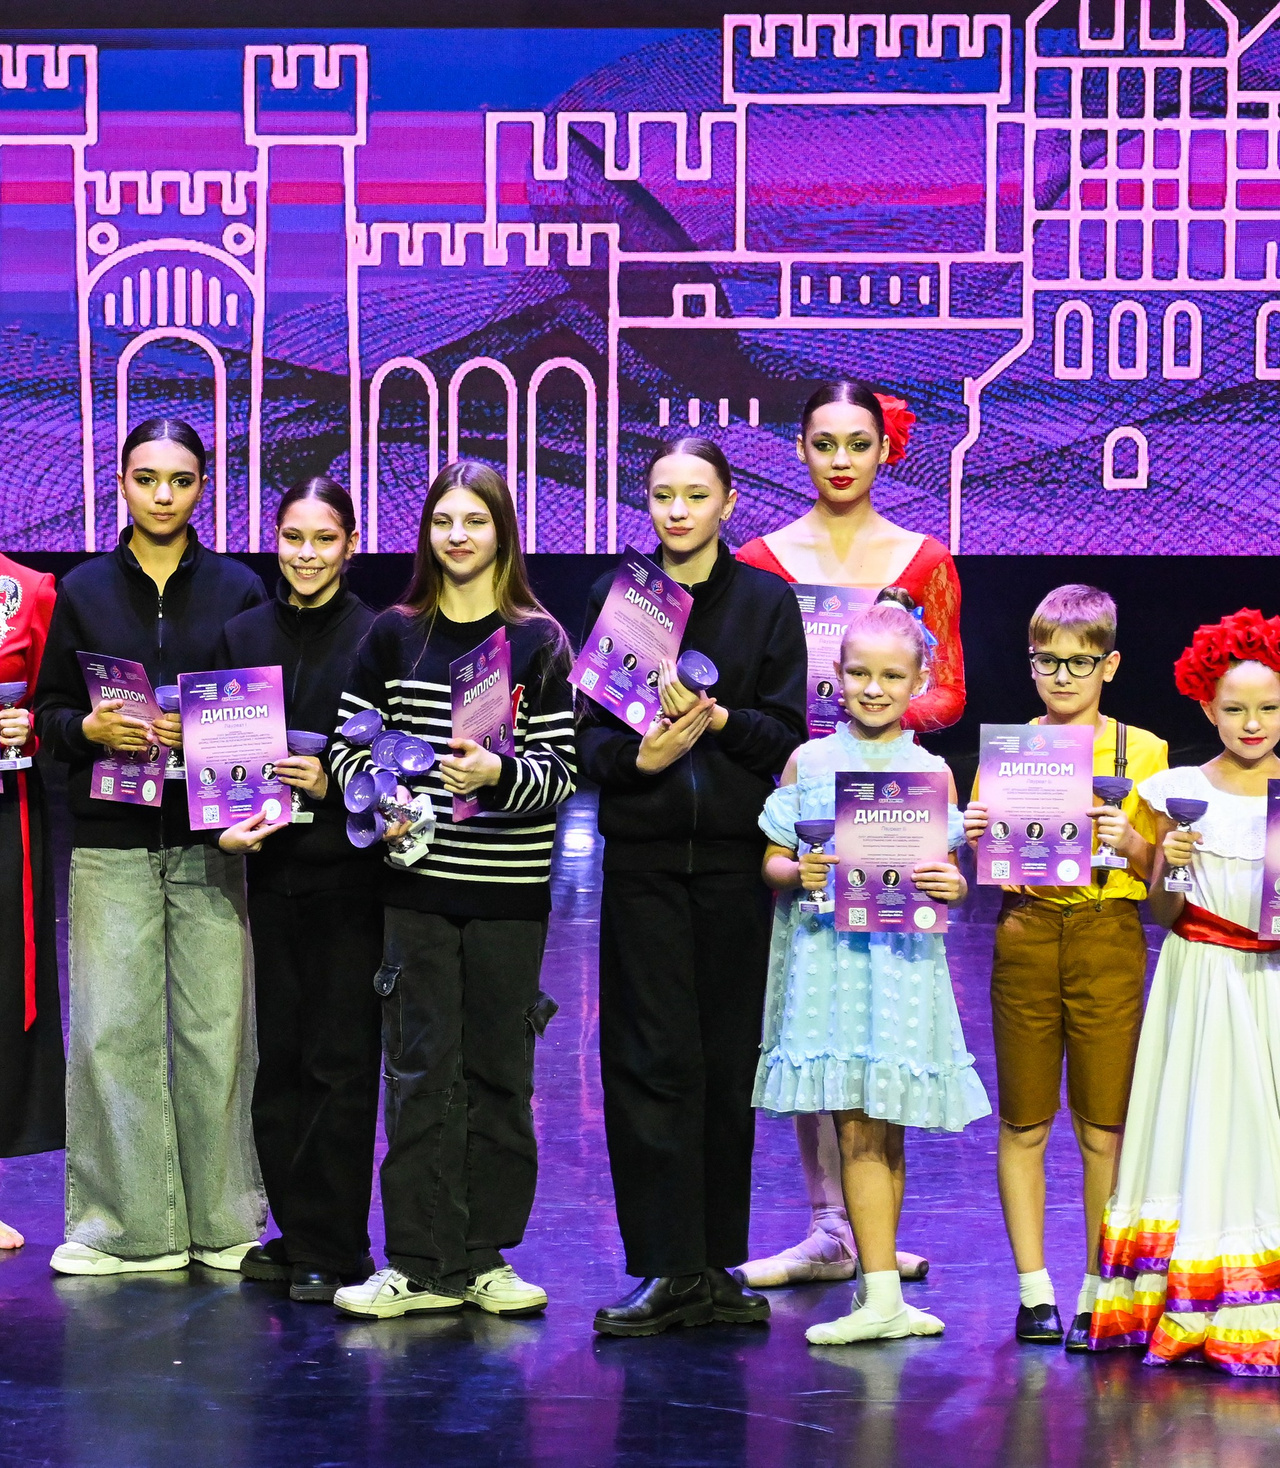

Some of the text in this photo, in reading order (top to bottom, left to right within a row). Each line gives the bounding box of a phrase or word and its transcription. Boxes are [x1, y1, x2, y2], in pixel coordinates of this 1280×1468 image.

[625, 587, 674, 633] ДИПЛОМ
[101, 686, 147, 704] ДИПЛОМ
[463, 668, 501, 707] ДИПЛОМ
[200, 704, 268, 725] ДИПЛОМ
[998, 762, 1074, 777] ДИПЛОМ
[854, 809, 930, 825] ДИПЛОМ
